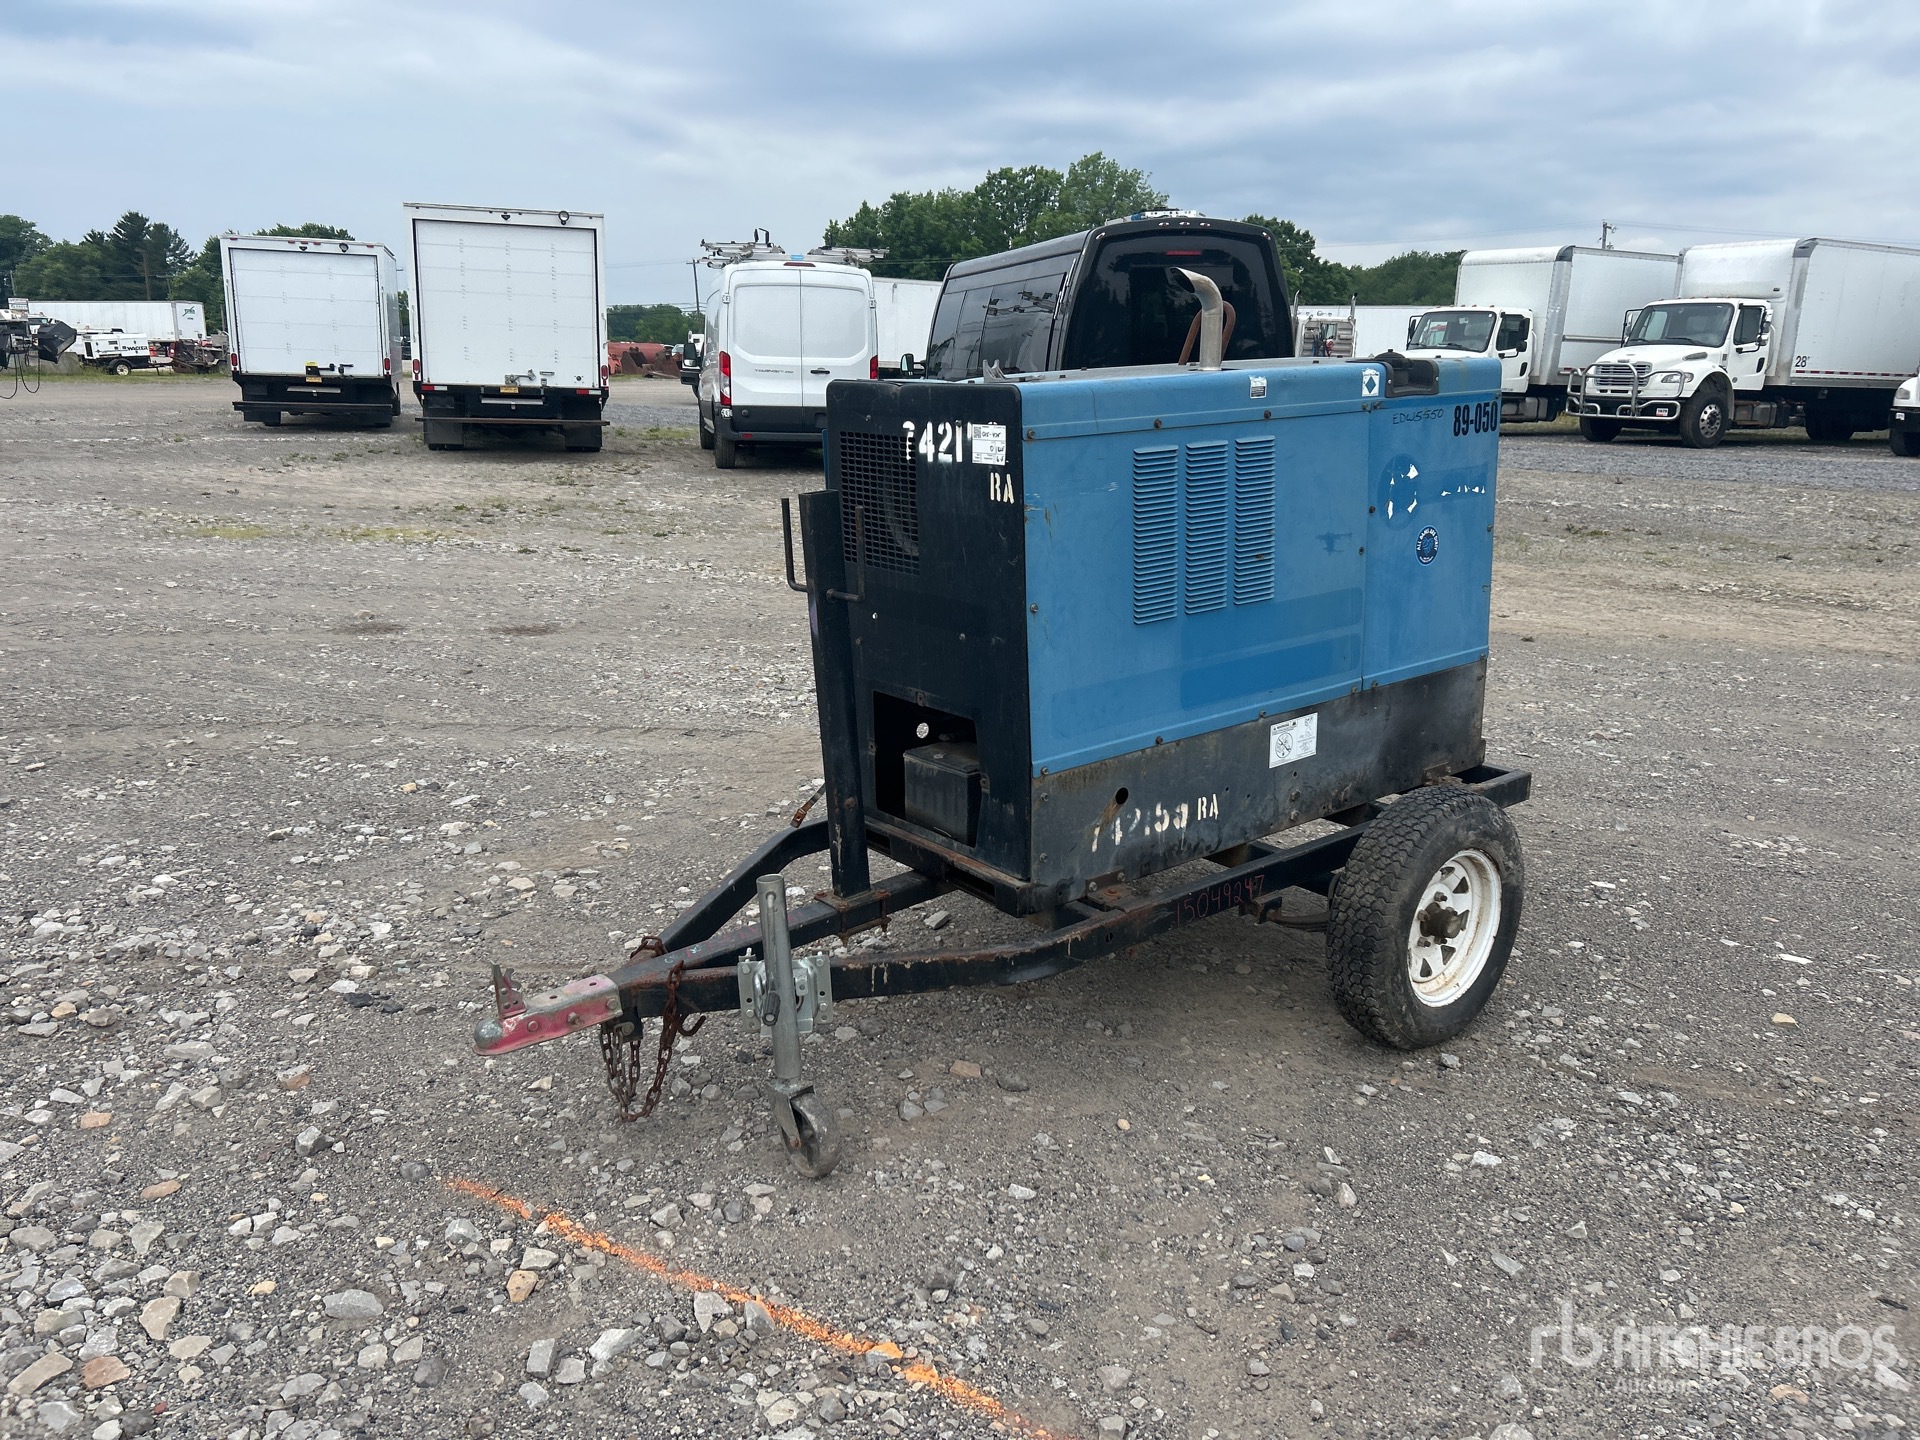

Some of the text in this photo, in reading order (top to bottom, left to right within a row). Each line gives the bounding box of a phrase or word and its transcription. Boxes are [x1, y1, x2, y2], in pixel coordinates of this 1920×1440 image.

[1392, 408, 1444, 425] EDW5550
[1453, 401, 1498, 437] 89-050
[990, 472, 1015, 504] RA
[1197, 793, 1219, 820] RA
